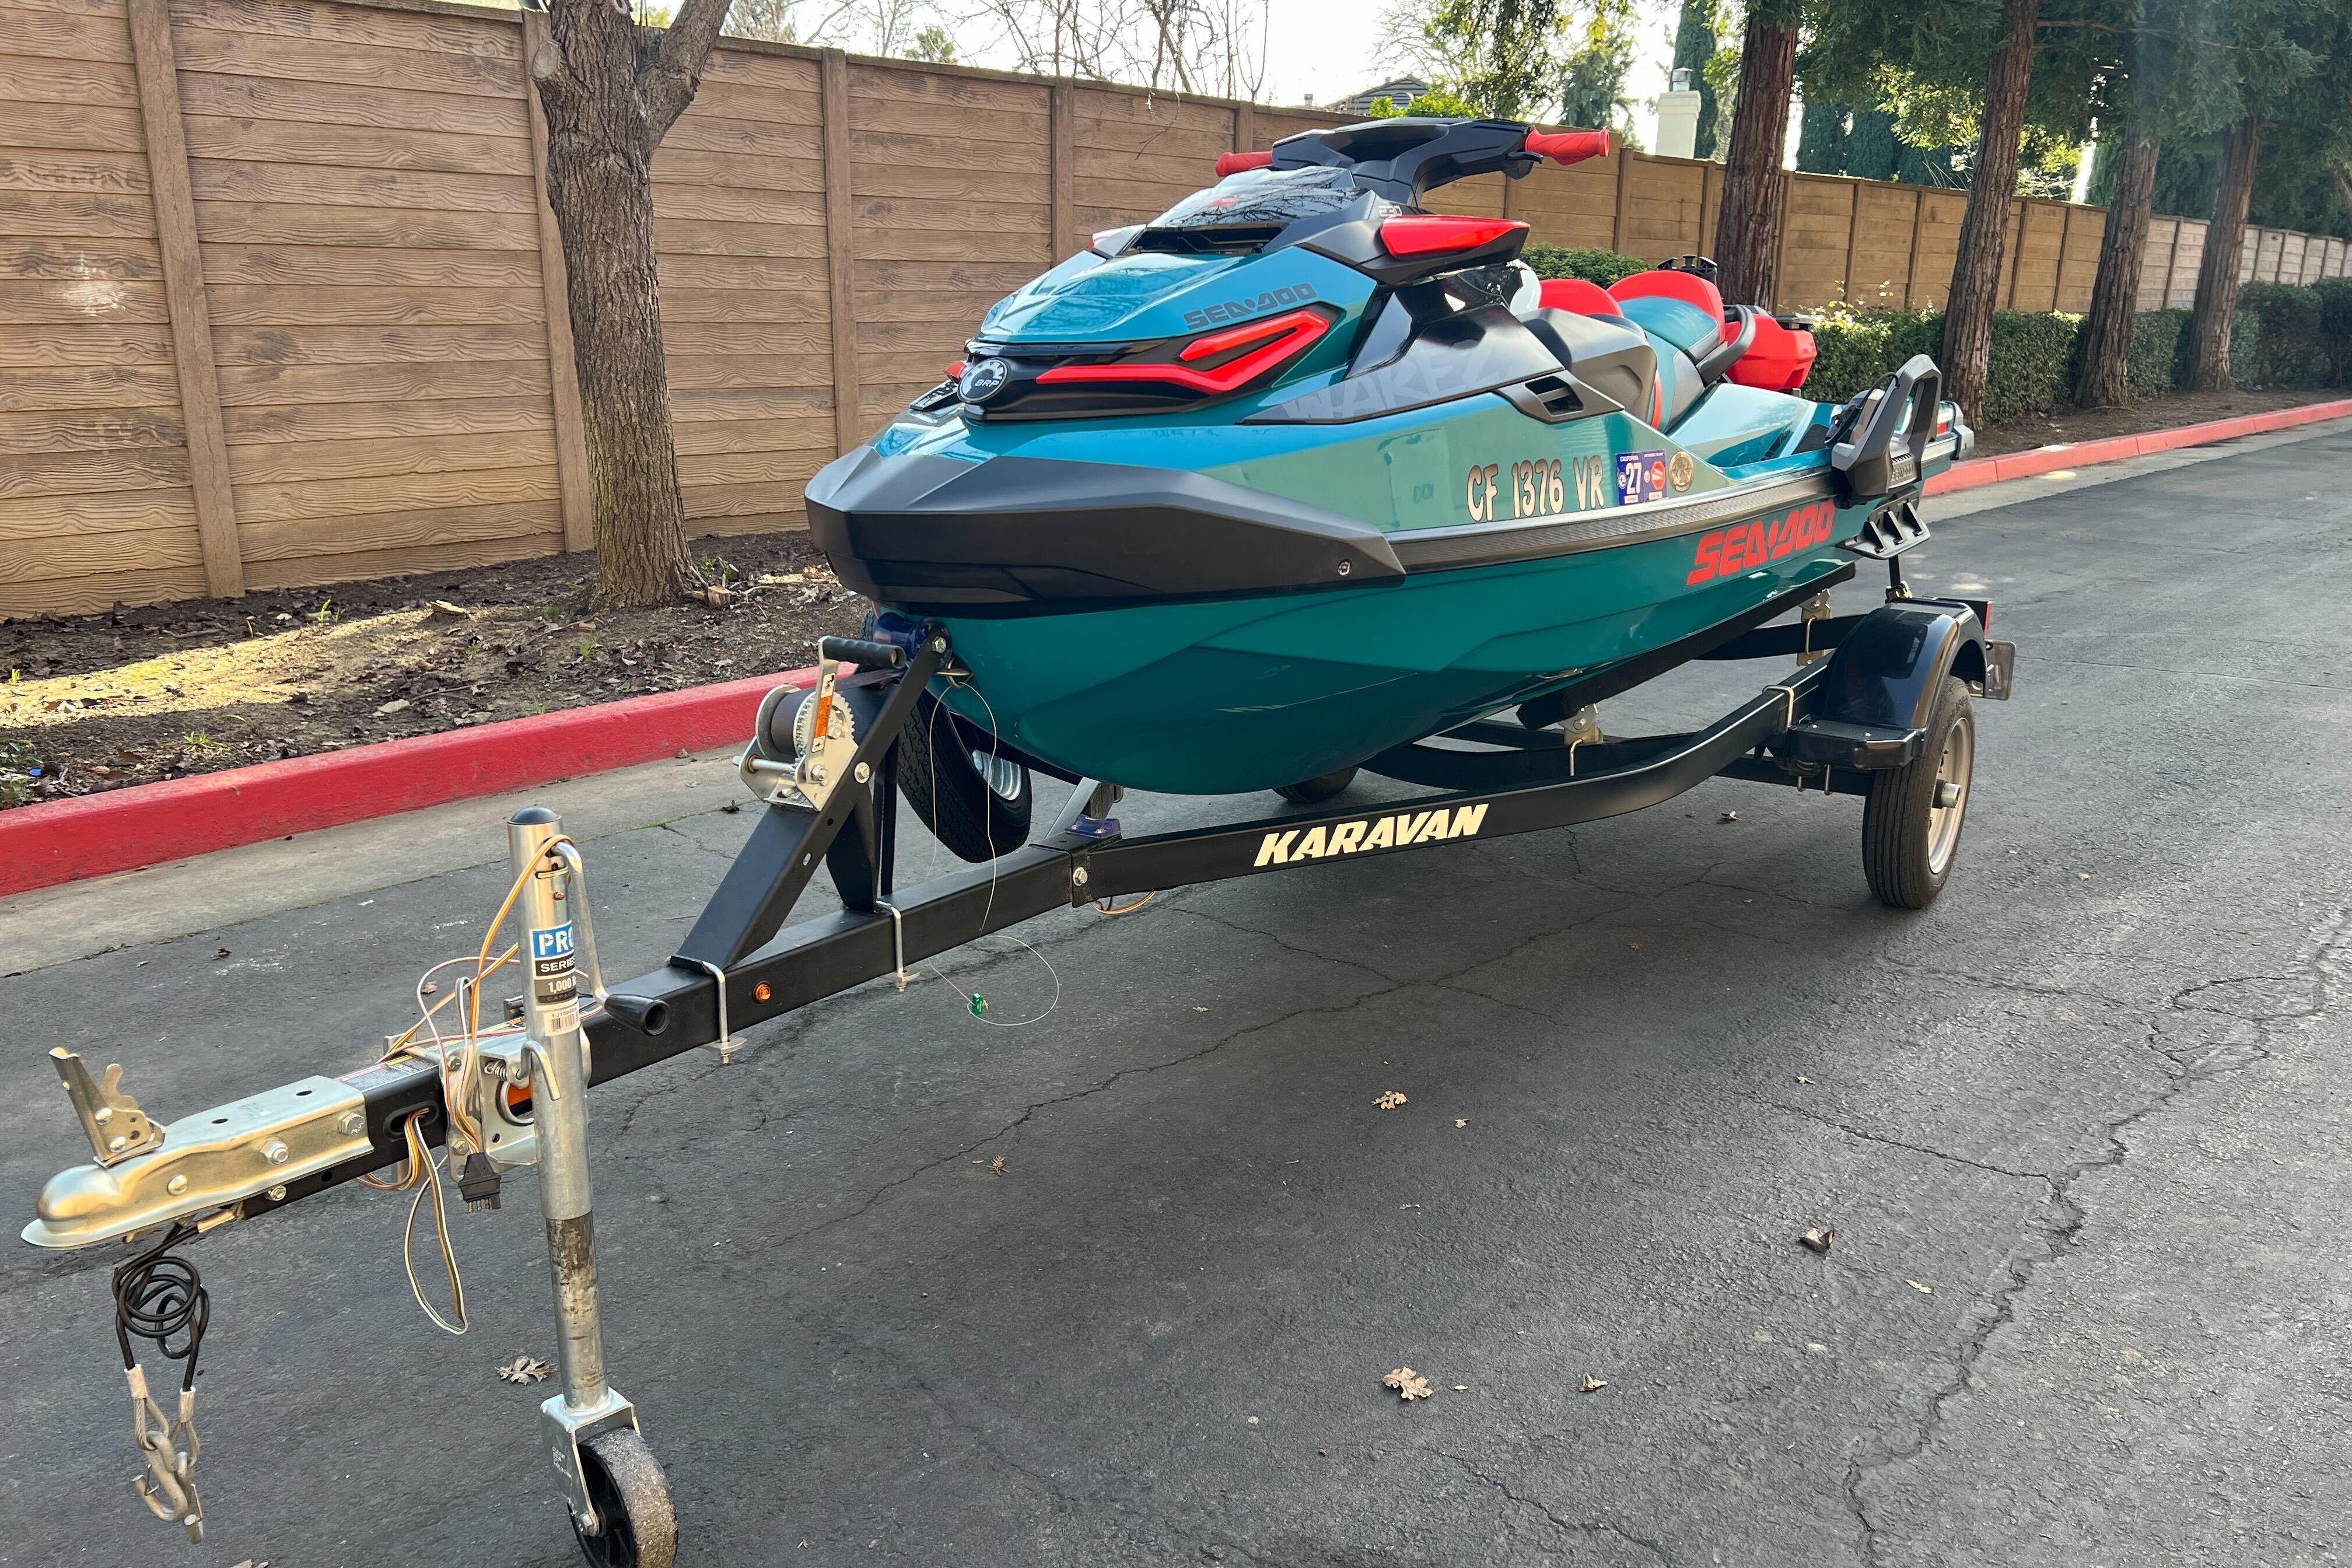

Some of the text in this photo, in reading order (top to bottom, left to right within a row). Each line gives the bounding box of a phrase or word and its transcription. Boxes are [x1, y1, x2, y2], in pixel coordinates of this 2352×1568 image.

[1378, 205, 1402, 218] 230
[1466, 463, 1499, 522] CF
[1511, 459, 1564, 519] 1376
[1573, 454, 1604, 511] VR
[1625, 462, 1642, 495] 27
[1253, 803, 1489, 867] KARAVAN
[548, 978, 572, 993] 1,000
